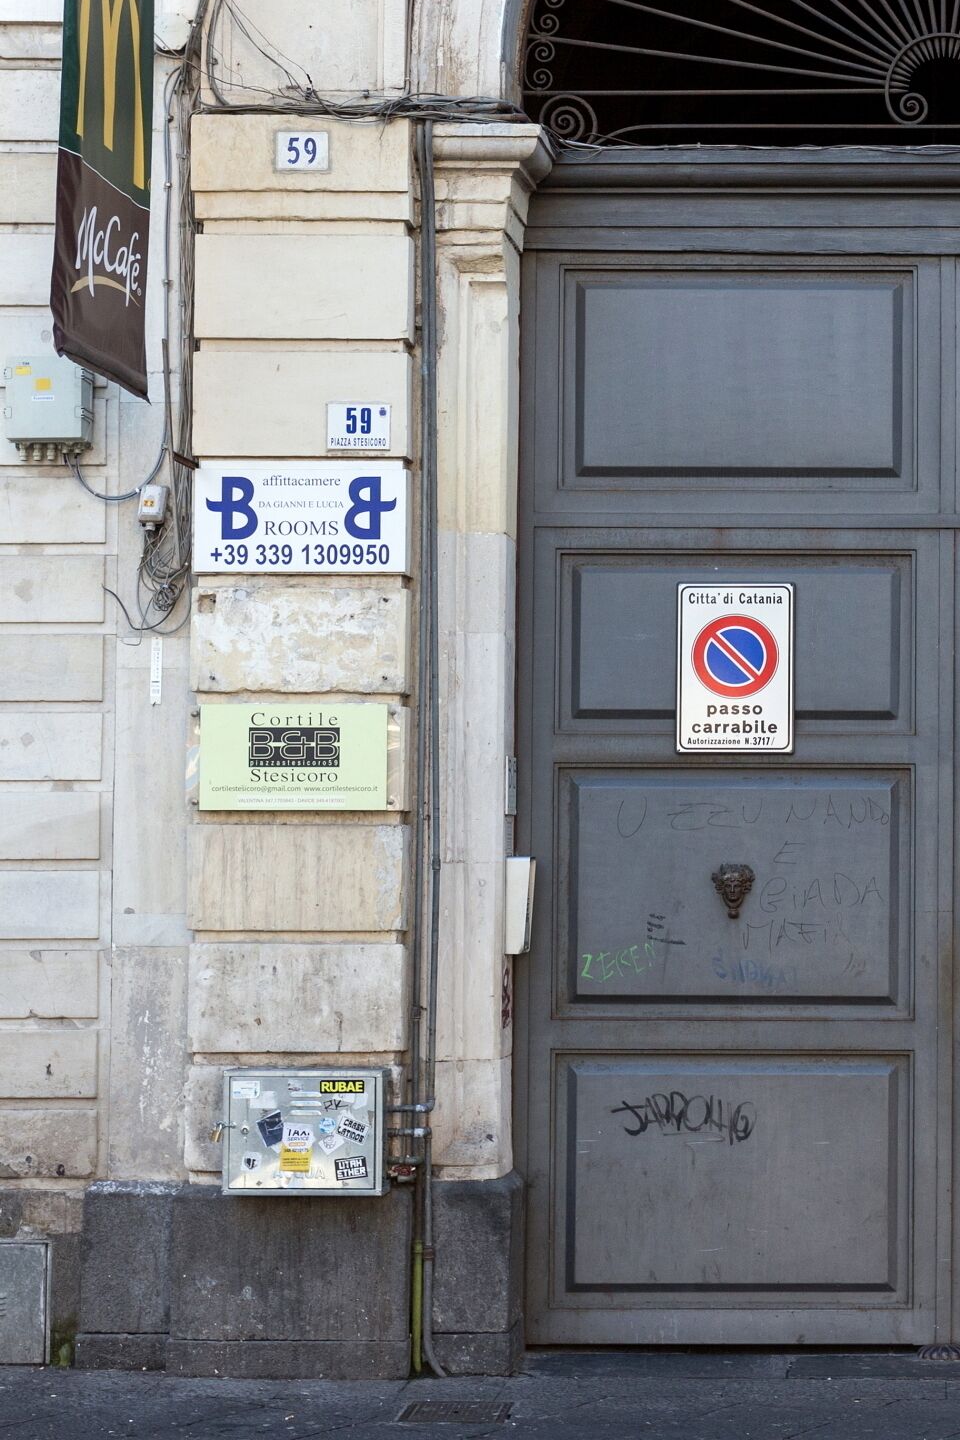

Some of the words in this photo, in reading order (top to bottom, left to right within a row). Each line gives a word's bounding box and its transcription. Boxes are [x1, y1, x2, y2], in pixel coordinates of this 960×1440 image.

[287, 137, 317, 164] 59
[346, 407, 371, 434] 59
[330, 438, 351, 446] PIAZZA
[353, 438, 386, 446] STESICORO
[262, 475, 341, 486] affittacamere
[264, 520, 339, 536] ROOMS
[210, 544, 249, 565] +39
[255, 544, 293, 565] 339
[301, 544, 390, 565] 1309950
[723, 592, 733, 604] di
[739, 592, 783, 604] Catania
[707, 704, 763, 718] passo
[251, 712, 338, 726] Cortile
[691, 720, 778, 734] carrabile
[249, 730, 340, 760] B&B
[687, 737, 741, 745] Autorizzazione
[250, 768, 338, 782] Stesicoro
[212, 785, 301, 793] cortilestesicoro@gmail.com
[321, 1081, 363, 1092] RUBAE
[337, 1126, 364, 1143] LATINOS
[338, 1159, 362, 1170] UTAH
[337, 1167, 366, 1178] ETHER
